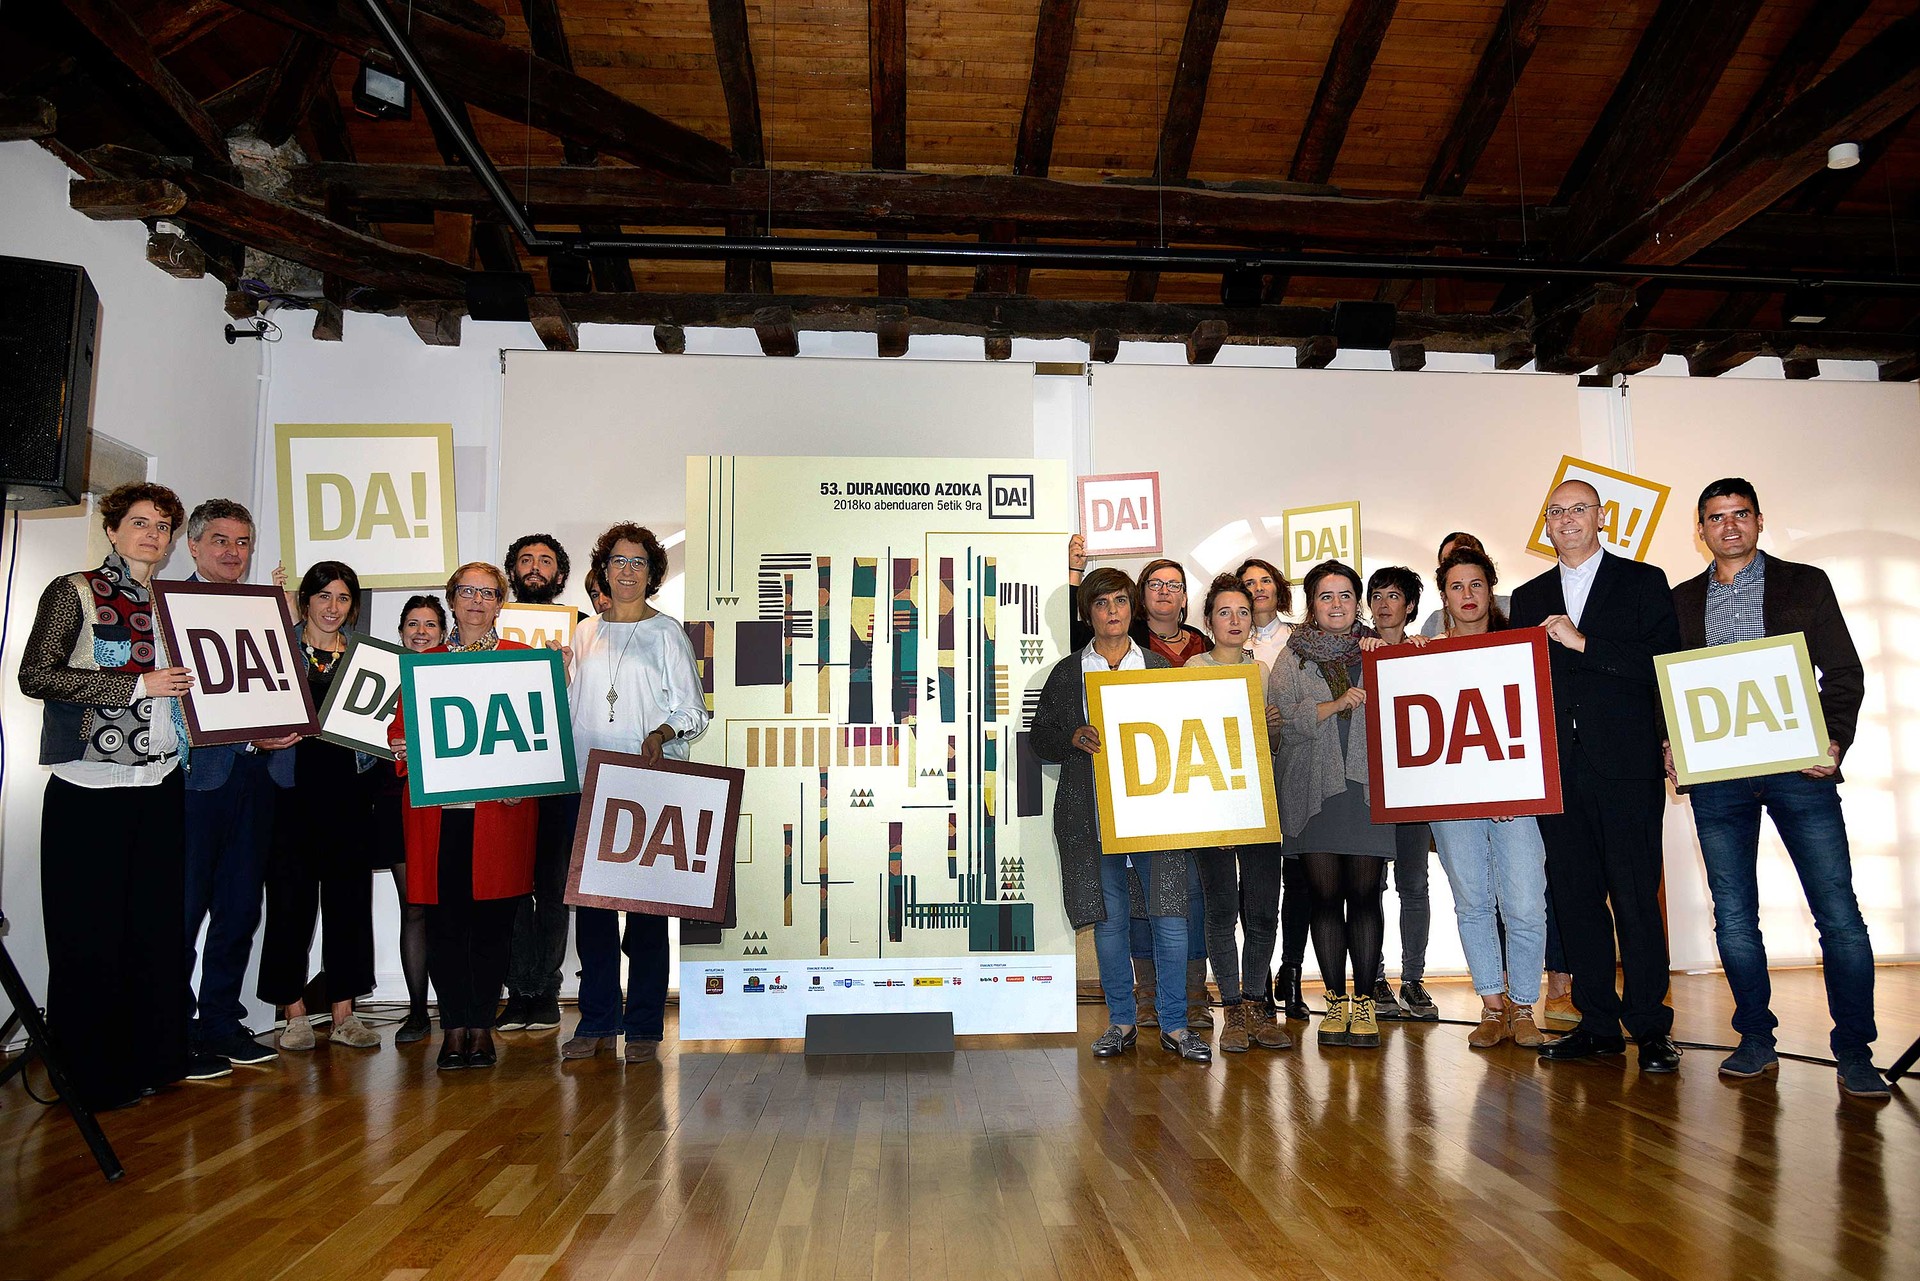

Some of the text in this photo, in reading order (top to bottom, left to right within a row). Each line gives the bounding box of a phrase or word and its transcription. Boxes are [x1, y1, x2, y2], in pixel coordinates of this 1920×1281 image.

[306, 471, 429, 541] DA!
[820, 482, 982, 496] 53. DURANGOKO AZOKA
[833, 499, 982, 511] 2018ko abenduaren 5etik 9ra
[995, 487, 1027, 507] DA!
[1091, 496, 1148, 532] DA!
[1294, 525, 1348, 563] DA!
[1602, 499, 1643, 548] A!
[186, 628, 291, 695] DA!
[342, 667, 402, 722] DA
[429, 691, 549, 759] DA!
[1684, 674, 1799, 743] DA!
[1118, 716, 1247, 797] DA!
[1393, 683, 1526, 769] DA!
[596, 797, 714, 874] DA!
